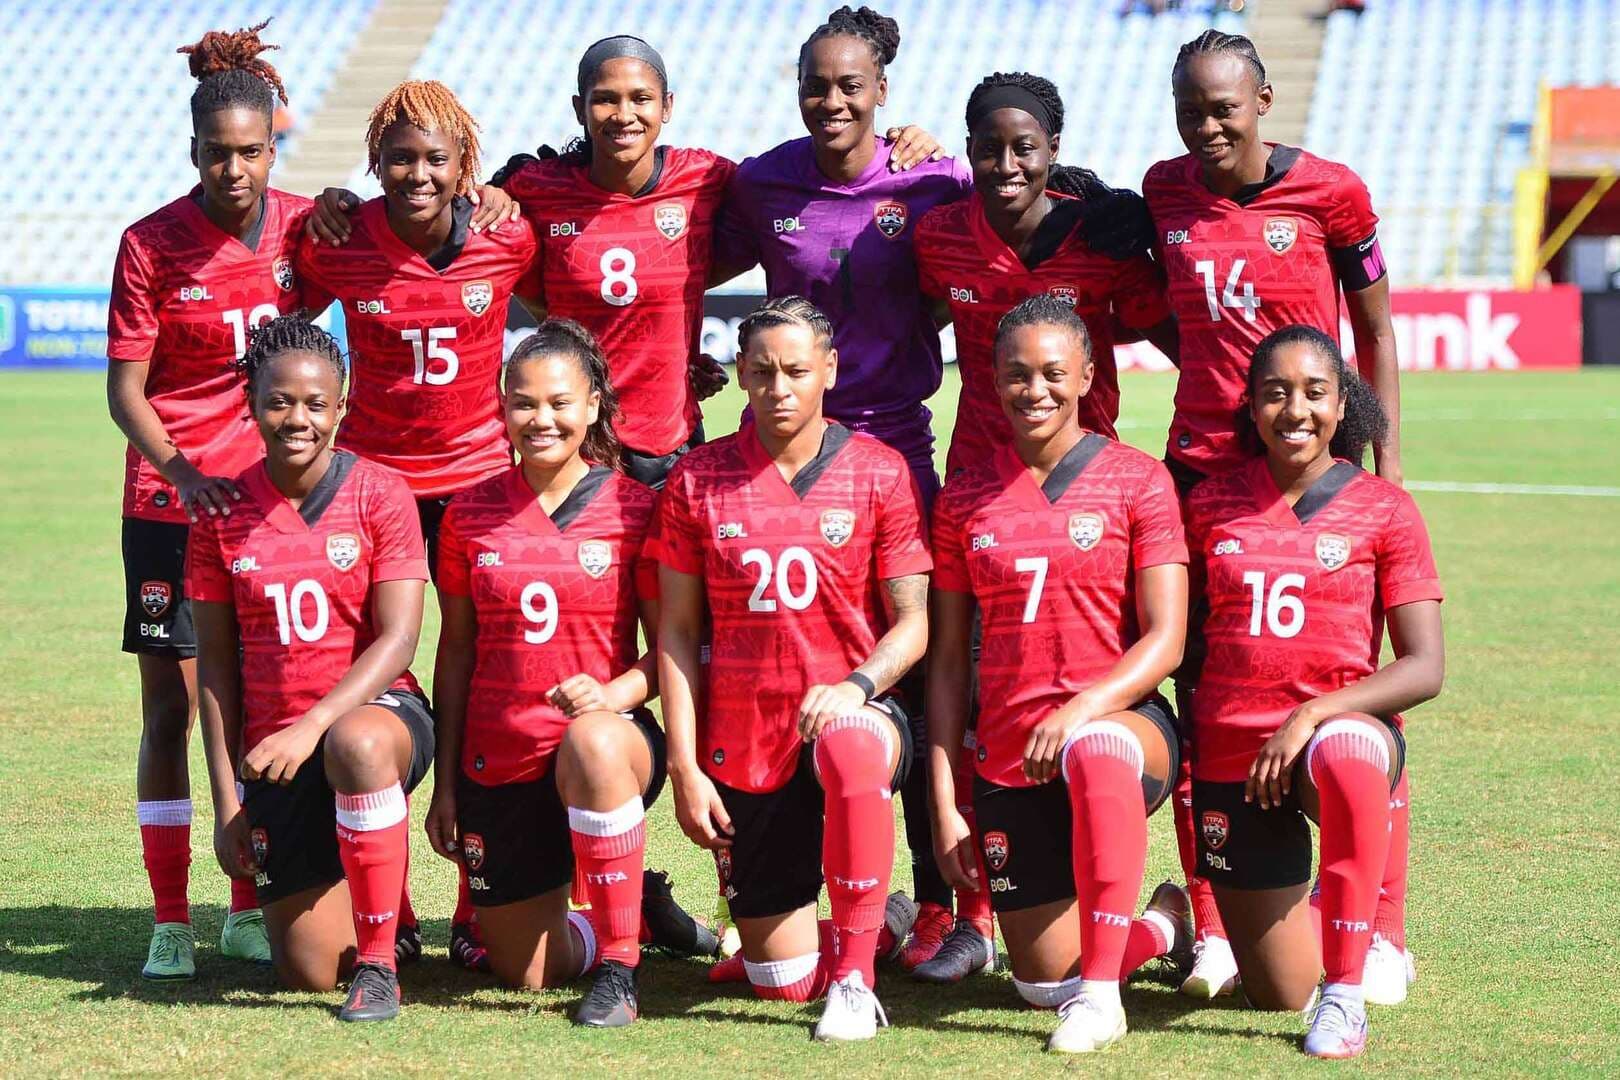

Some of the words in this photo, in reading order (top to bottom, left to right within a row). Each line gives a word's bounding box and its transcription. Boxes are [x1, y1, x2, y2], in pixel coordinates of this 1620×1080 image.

[550, 223, 582, 237] BOL
[773, 217, 805, 232] BOL
[1166, 230, 1191, 244] BOL
[600, 247, 637, 306] 8
[180, 287, 213, 301] BOL
[950, 288, 978, 304] BOL
[1195, 260, 1261, 322] 14
[357, 301, 391, 314] BOL
[401, 327, 459, 386] 15
[717, 524, 747, 538] BOL
[973, 534, 999, 552] BOL
[1215, 540, 1244, 555] BOL
[232, 557, 261, 574] BOL
[477, 553, 503, 567] BOL
[741, 546, 817, 612] 20
[1015, 557, 1048, 623] 7
[264, 579, 329, 645] 10
[520, 582, 558, 644] 9
[1243, 572, 1306, 638] 16
[140, 623, 170, 638] BOL
[1205, 816, 1224, 824] TTFA
[1206, 852, 1232, 871] BOL
[990, 878, 1017, 892] BOL
[1092, 911, 1129, 927] TTFA
[1332, 919, 1369, 932] TTFA
